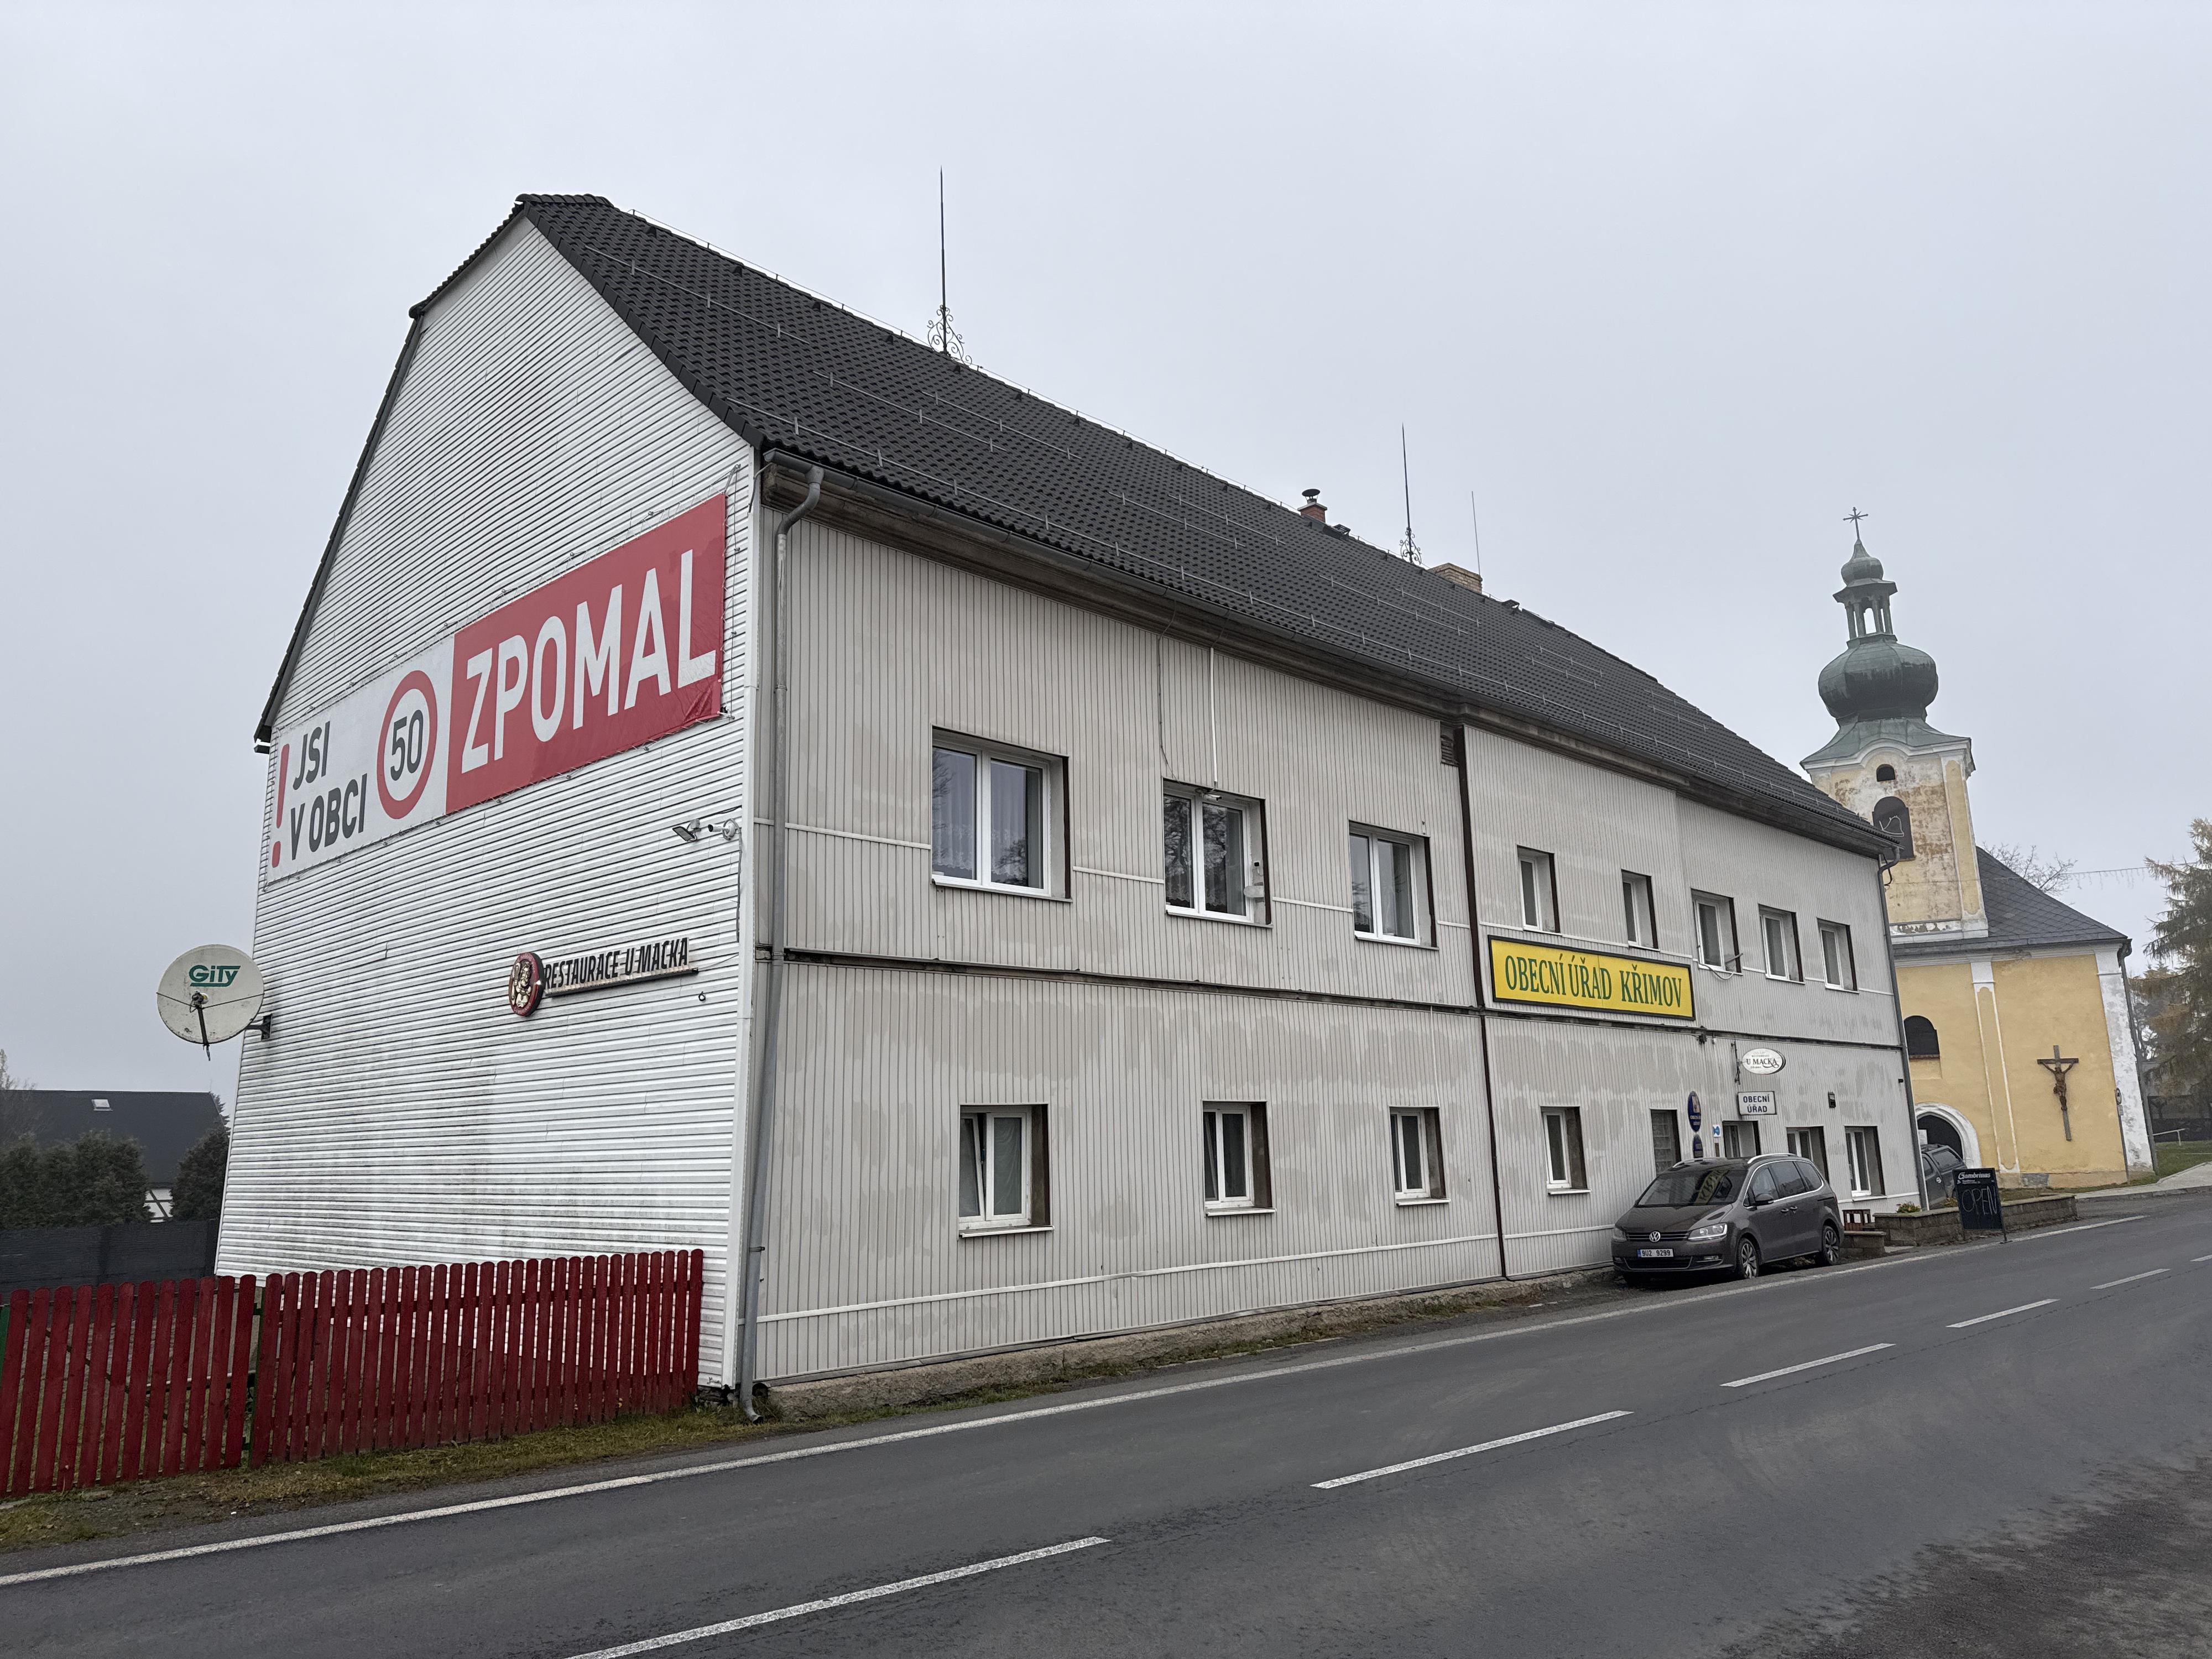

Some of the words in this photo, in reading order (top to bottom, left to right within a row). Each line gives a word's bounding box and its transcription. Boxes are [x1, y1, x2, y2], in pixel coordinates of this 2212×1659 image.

[462, 549, 716, 774] ZPOMAL
[293, 721, 330, 790] JSI
[390, 709, 424, 781] 50
[291, 802, 305, 860] V
[309, 773, 367, 852] OBCI
[544, 950, 620, 989] RESTAURACE
[625, 947, 634, 975] U
[637, 937, 688, 973] MACKA
[1505, 953, 1566, 995] OBECNÍ
[1567, 955, 1612, 1000] ÚŘAD
[1619, 963, 1682, 1008] KŘIMOV
[1752, 1058, 1779, 1068] MACKA
[1743, 1094, 1770, 1103] OBECNÍ
[1747, 1104, 1767, 1113] ÚŘAD
[1962, 1186, 1997, 1215] OPEN
